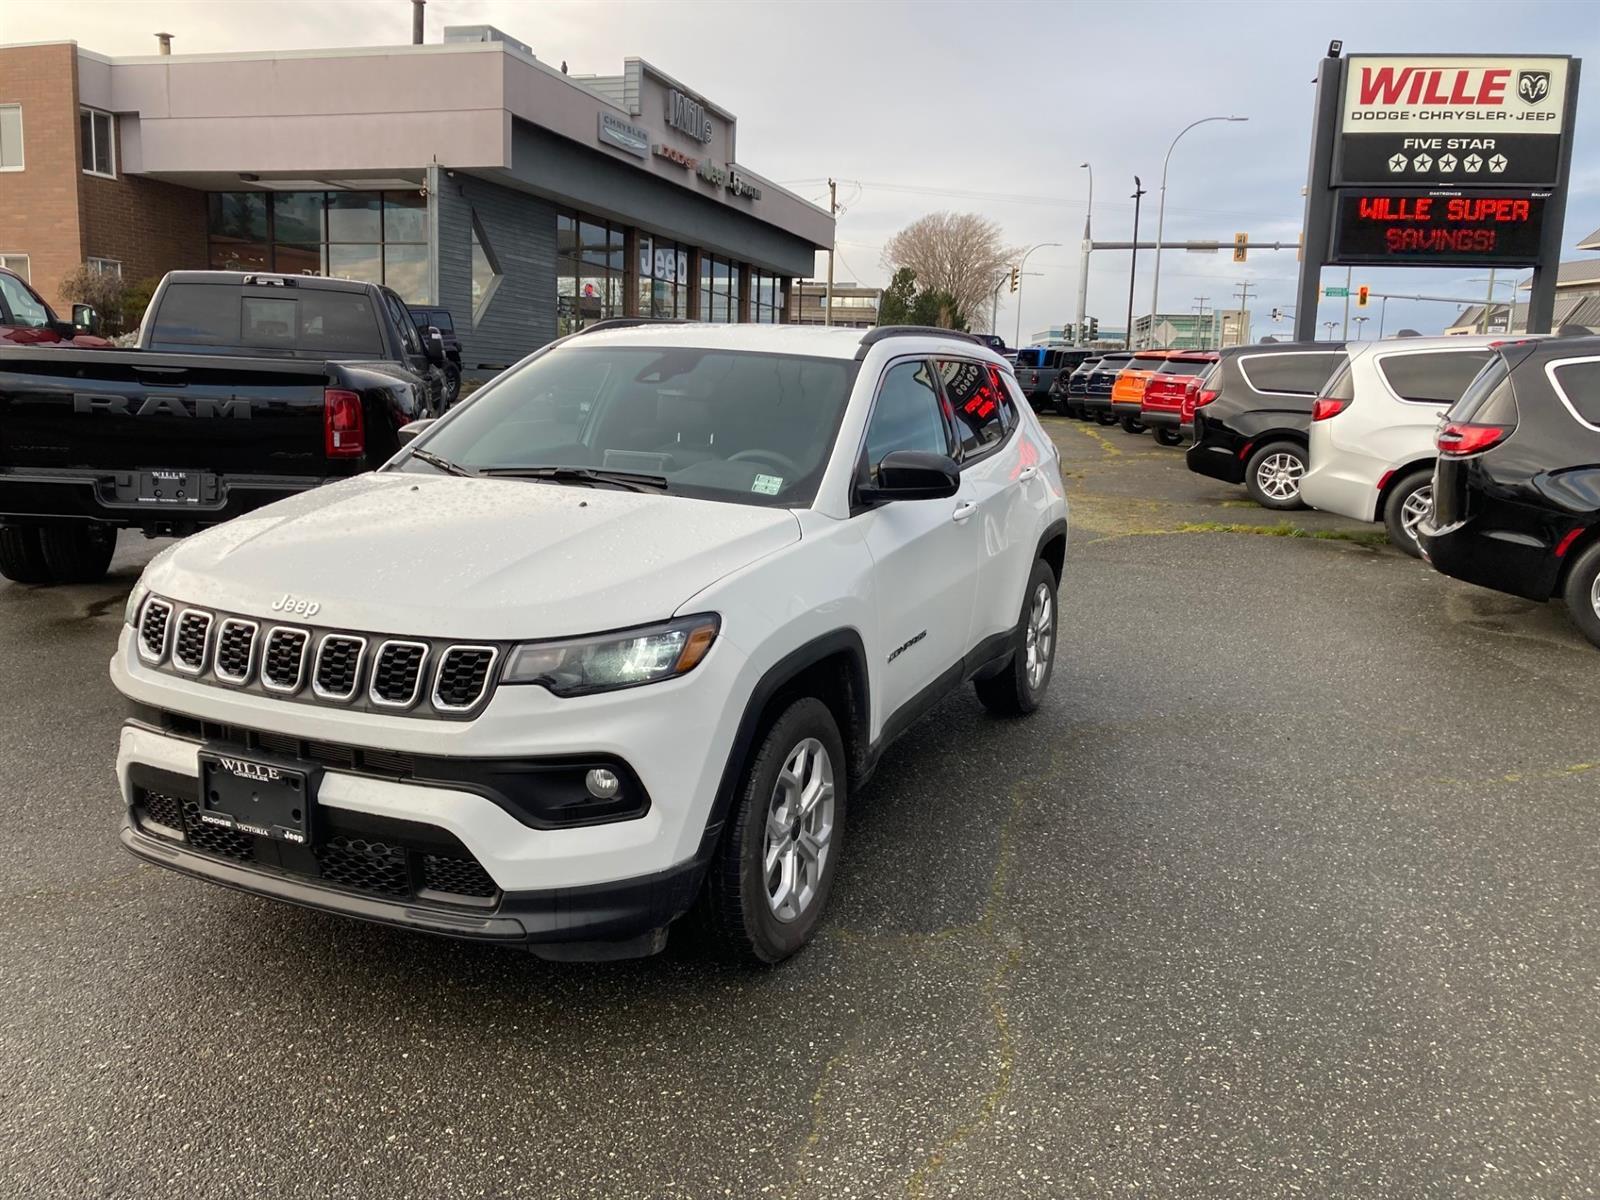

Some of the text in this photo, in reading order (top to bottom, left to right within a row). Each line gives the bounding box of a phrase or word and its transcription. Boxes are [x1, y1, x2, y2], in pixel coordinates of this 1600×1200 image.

[1359, 67, 1512, 105] WILLE
[603, 115, 648, 140] CHRYSLER
[1351, 111, 1556, 121] DODGE CHRYSLER JEEP
[1403, 138, 1496, 150] FIVE STAR
[1359, 197, 1529, 221] WILLE SUPER
[1385, 228, 1496, 252] SAVINGS!
[641, 237, 688, 283] Jeep
[73, 393, 252, 419] RAM
[271, 594, 321, 619] Jeep
[219, 758, 280, 780] WILLE
[201, 815, 304, 843] DODGE VICTORIA Jeep
